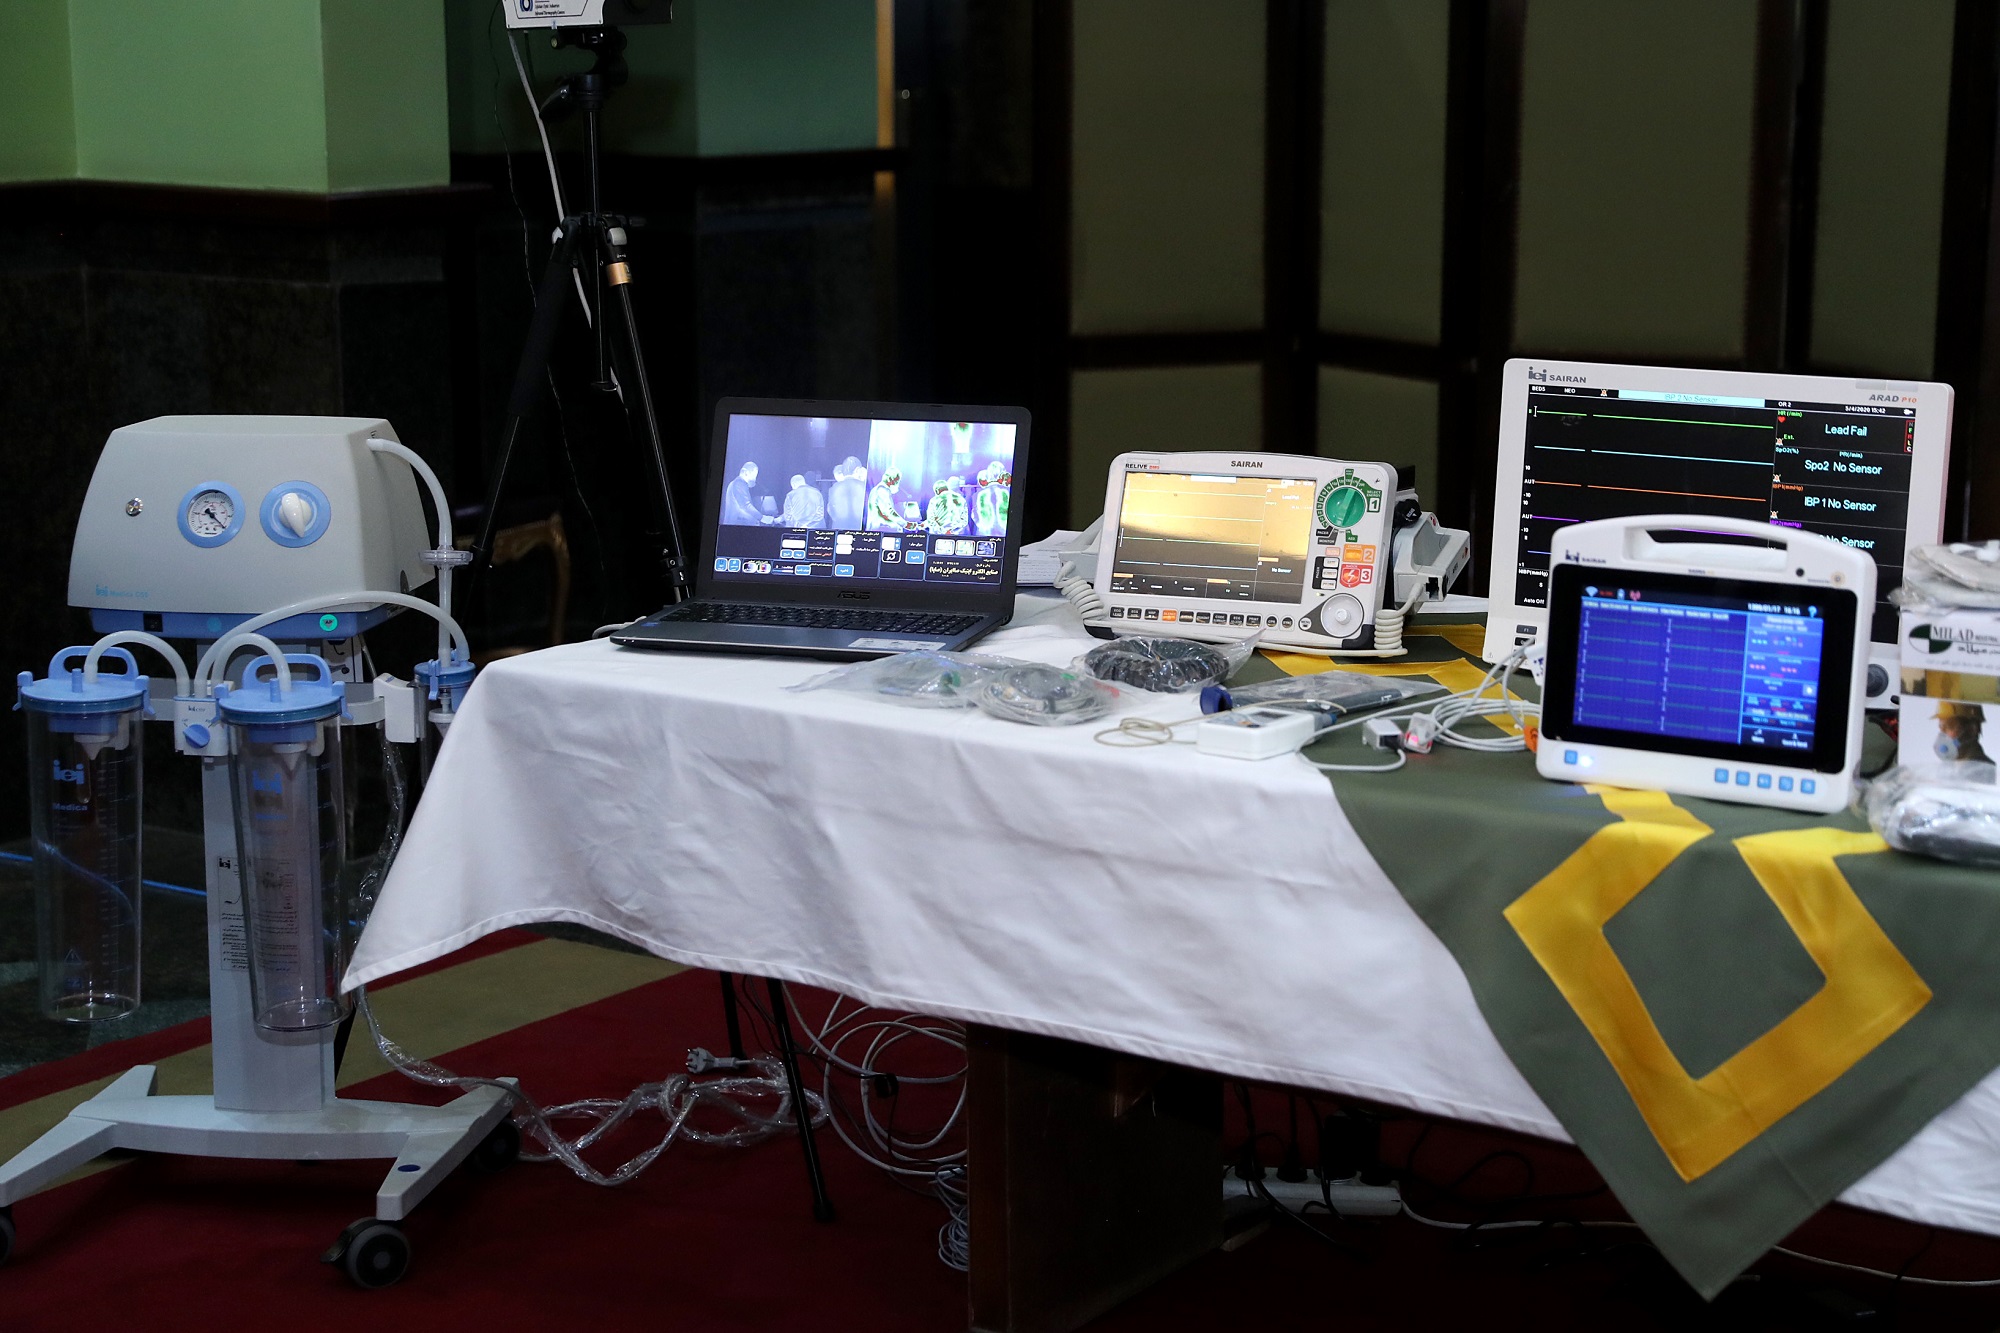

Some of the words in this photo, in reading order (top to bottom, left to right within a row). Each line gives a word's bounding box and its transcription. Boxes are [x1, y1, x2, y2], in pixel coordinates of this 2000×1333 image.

[1549, 374, 1587, 384] SAIRAN
[1694, 396, 1718, 404] Sensor
[1869, 394, 1900, 403] ARAD
[1901, 396, 1917, 404] P10
[1825, 423, 1850, 436] Lead
[1850, 425, 1868, 437] Fail
[1231, 460, 1263, 469] SAIRAN
[1804, 459, 1830, 473] Spo2
[1833, 461, 1847, 472] No
[1848, 462, 1883, 475] Sensor
[1371, 499, 1378, 510] 1
[1804, 496, 1820, 506] IBP
[1821, 499, 1827, 507] 1
[1827, 498, 1841, 509] No
[1842, 500, 1877, 511] Sensor
[1841, 536, 1875, 549] Sensor
[1365, 550, 1373, 561] 2
[1362, 570, 1370, 580] 3
[837, 591, 871, 600] ASUS
[1932, 625, 1974, 641] MILAD
